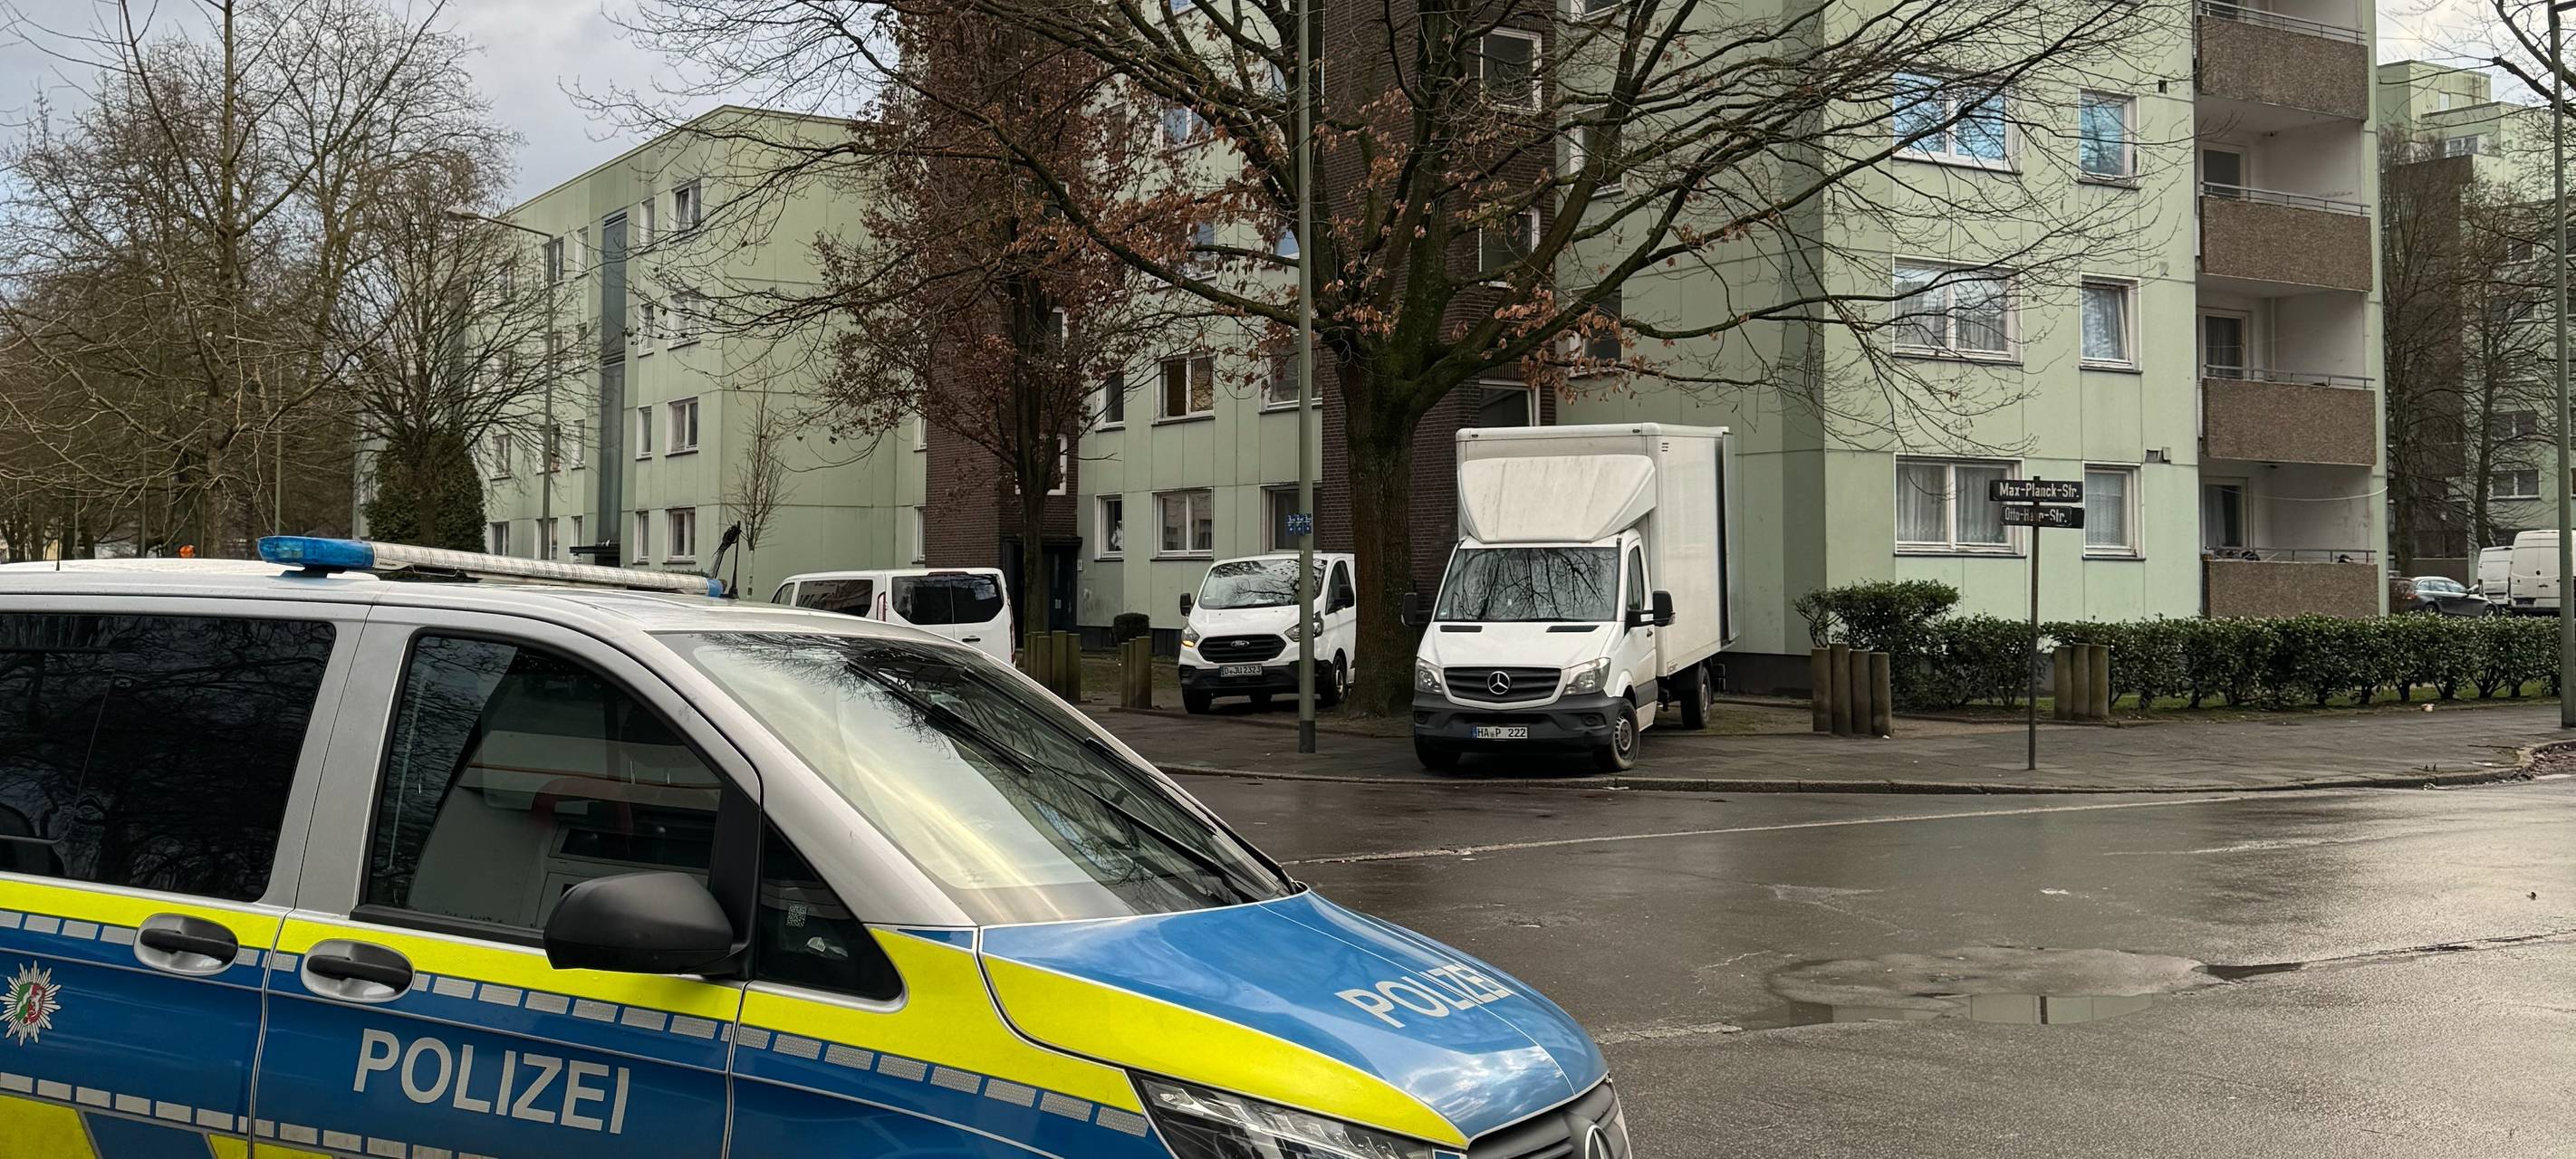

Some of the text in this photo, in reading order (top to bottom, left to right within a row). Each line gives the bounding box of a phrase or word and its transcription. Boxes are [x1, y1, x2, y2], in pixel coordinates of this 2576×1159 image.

[1999, 482, 2080, 498] Max-Planck-Str.
[1477, 728, 1490, 738] HA
[1508, 728, 1526, 738] 222
[352, 1028, 630, 1135] POLIZEI
